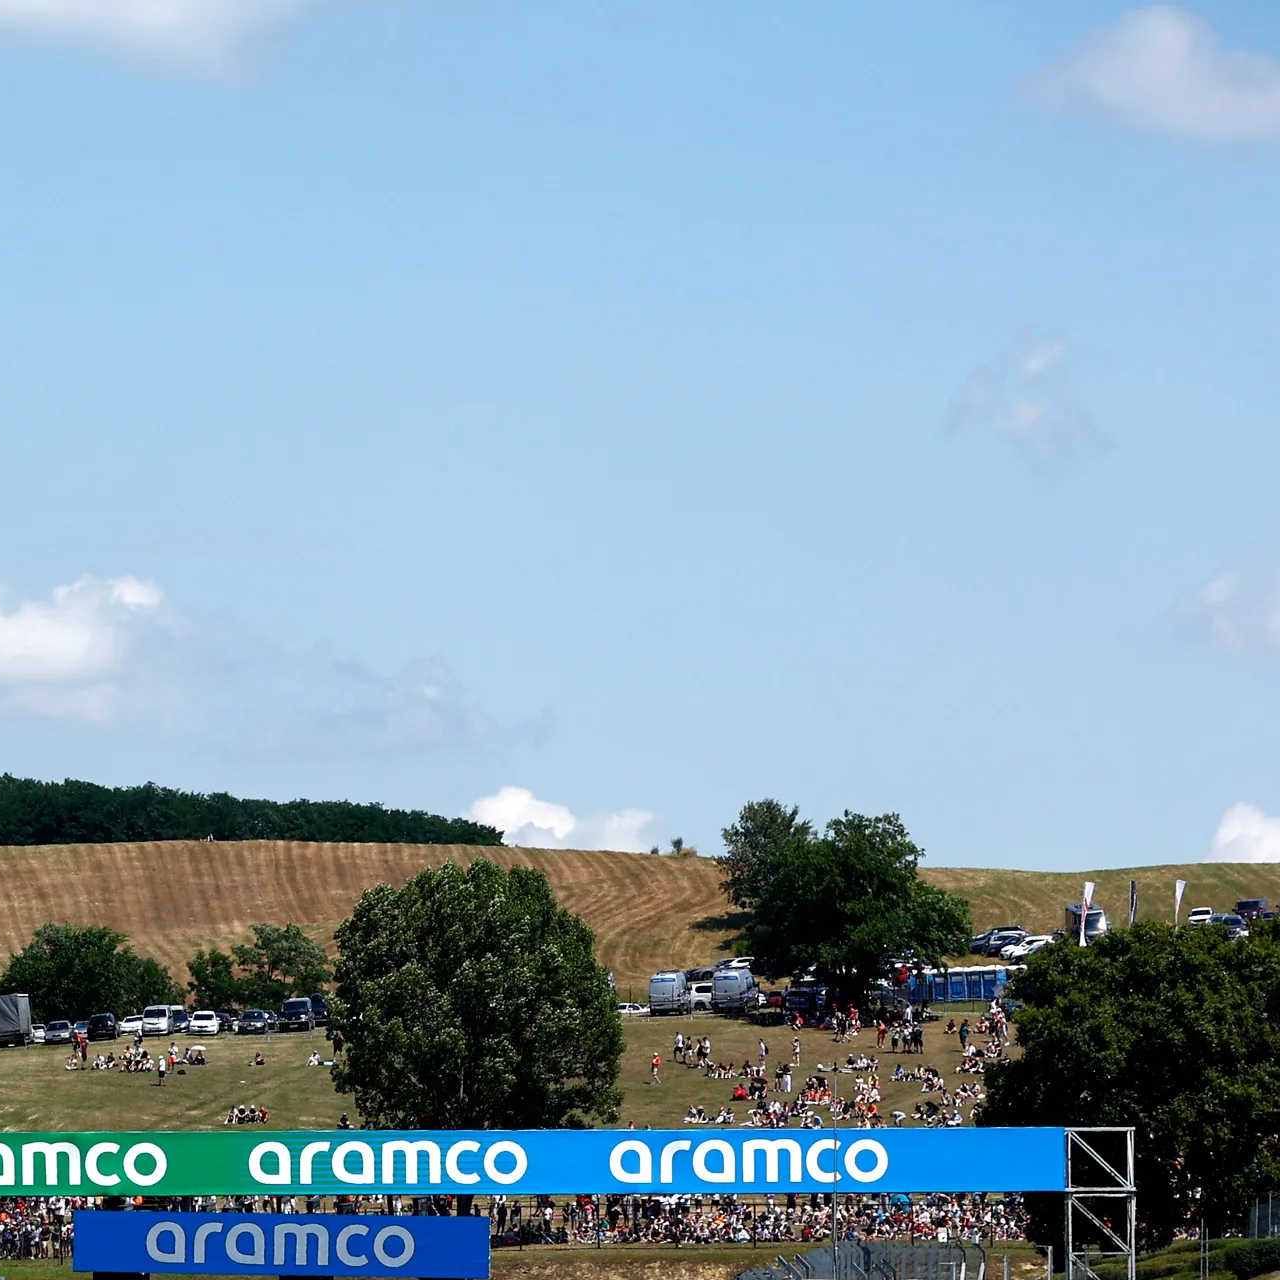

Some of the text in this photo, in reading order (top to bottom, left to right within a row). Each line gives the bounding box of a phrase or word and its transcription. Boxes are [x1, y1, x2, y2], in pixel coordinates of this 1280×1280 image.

[248, 1140, 529, 1185] aramco
[609, 1138, 889, 1184] aramco
[147, 1221, 416, 1268] aramco
